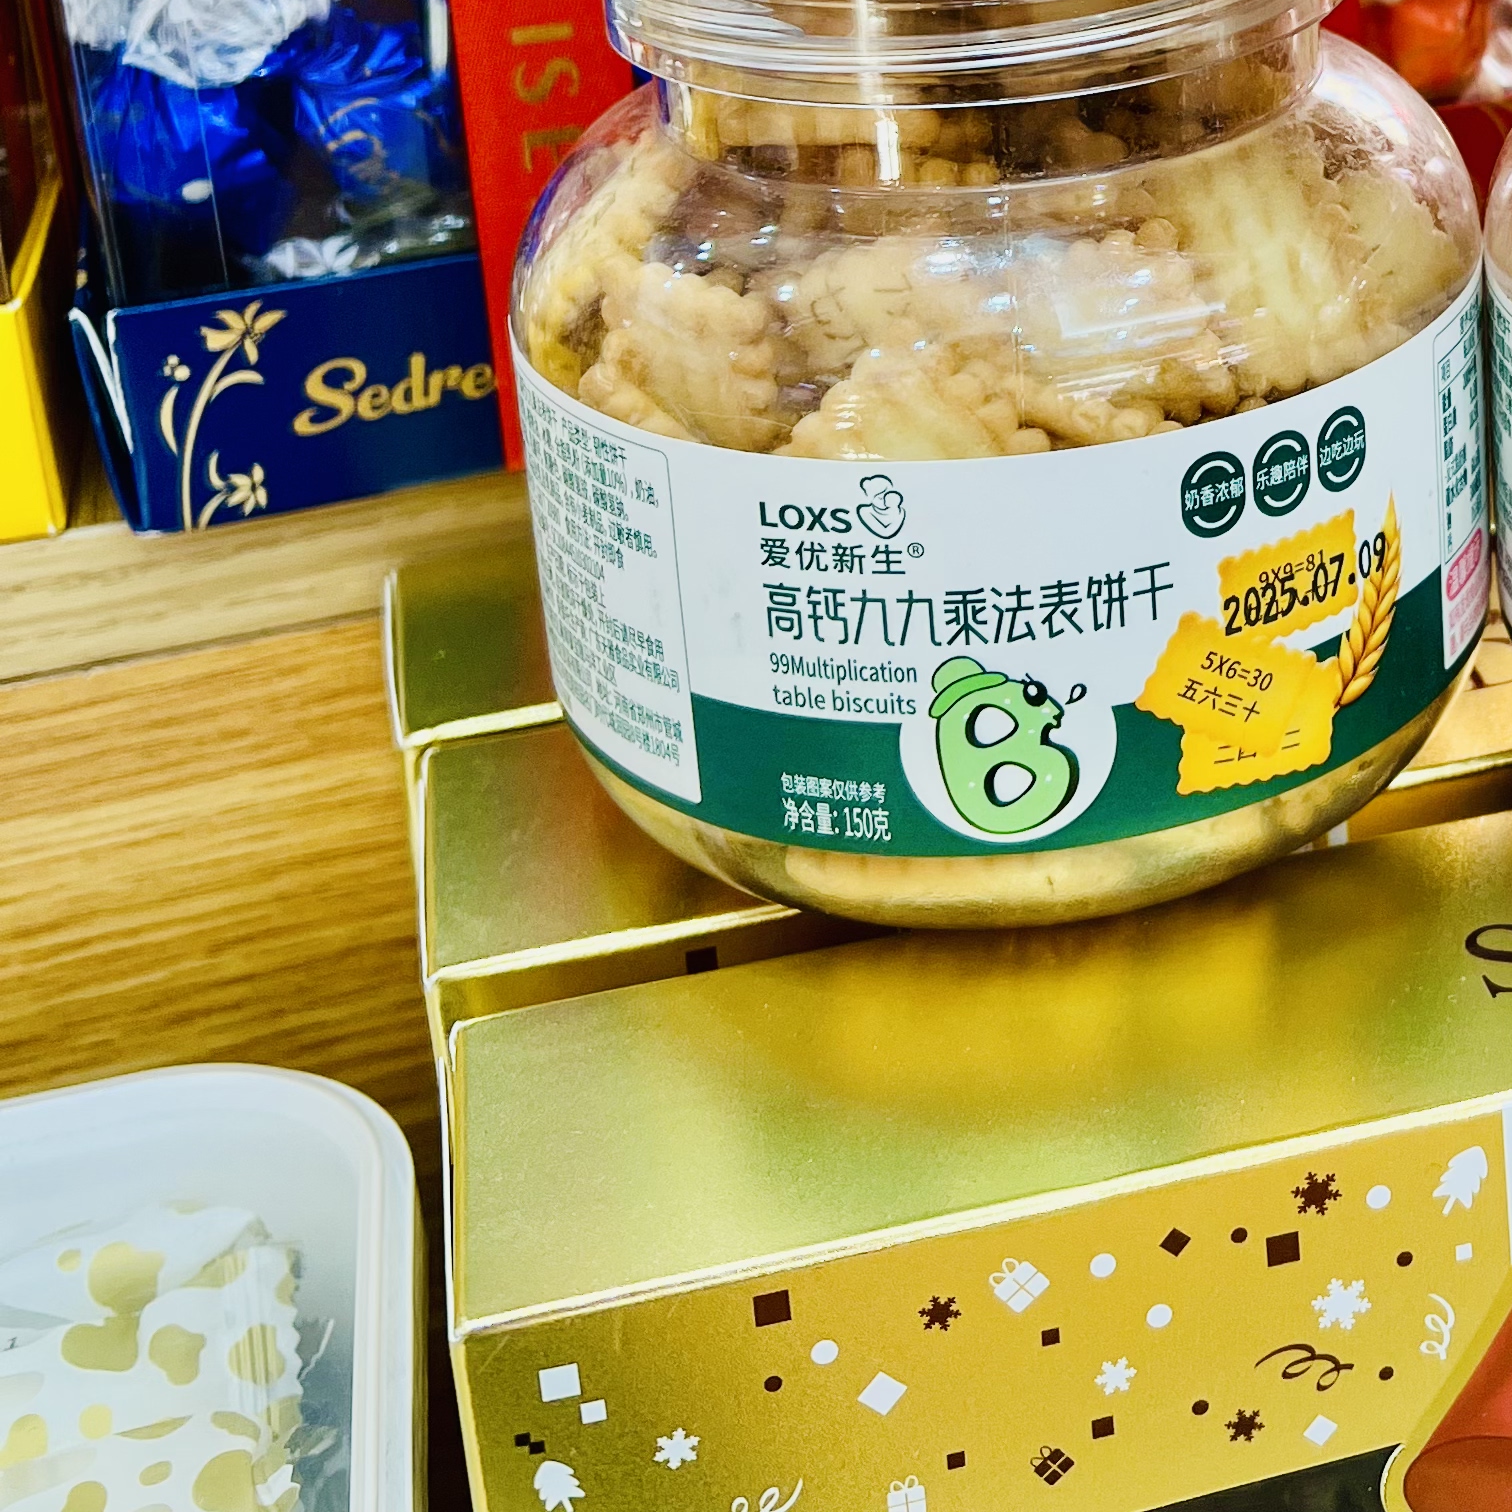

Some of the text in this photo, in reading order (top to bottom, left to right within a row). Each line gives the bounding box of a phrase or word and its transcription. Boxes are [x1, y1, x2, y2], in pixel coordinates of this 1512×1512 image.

[509, 22, 582, 106] IS
[1318, 428, 1366, 468] 边吃边玩
[1255, 454, 1310, 491] 乐趣陪伴
[1184, 475, 1245, 512] 奶香浓郁
[758, 500, 853, 537] LOXS
[1223, 531, 1387, 638] 2025.07.09
[762, 560, 1175, 648] 高钙九九乘法表饼干
[769, 652, 919, 686] 99Multiplication
[1200, 650, 1274, 693] 5X6=30
[773, 684, 918, 717] table biscuits
[1176, 677, 1262, 725] 五六三十
[780, 771, 887, 804] 包装图案仅供参考
